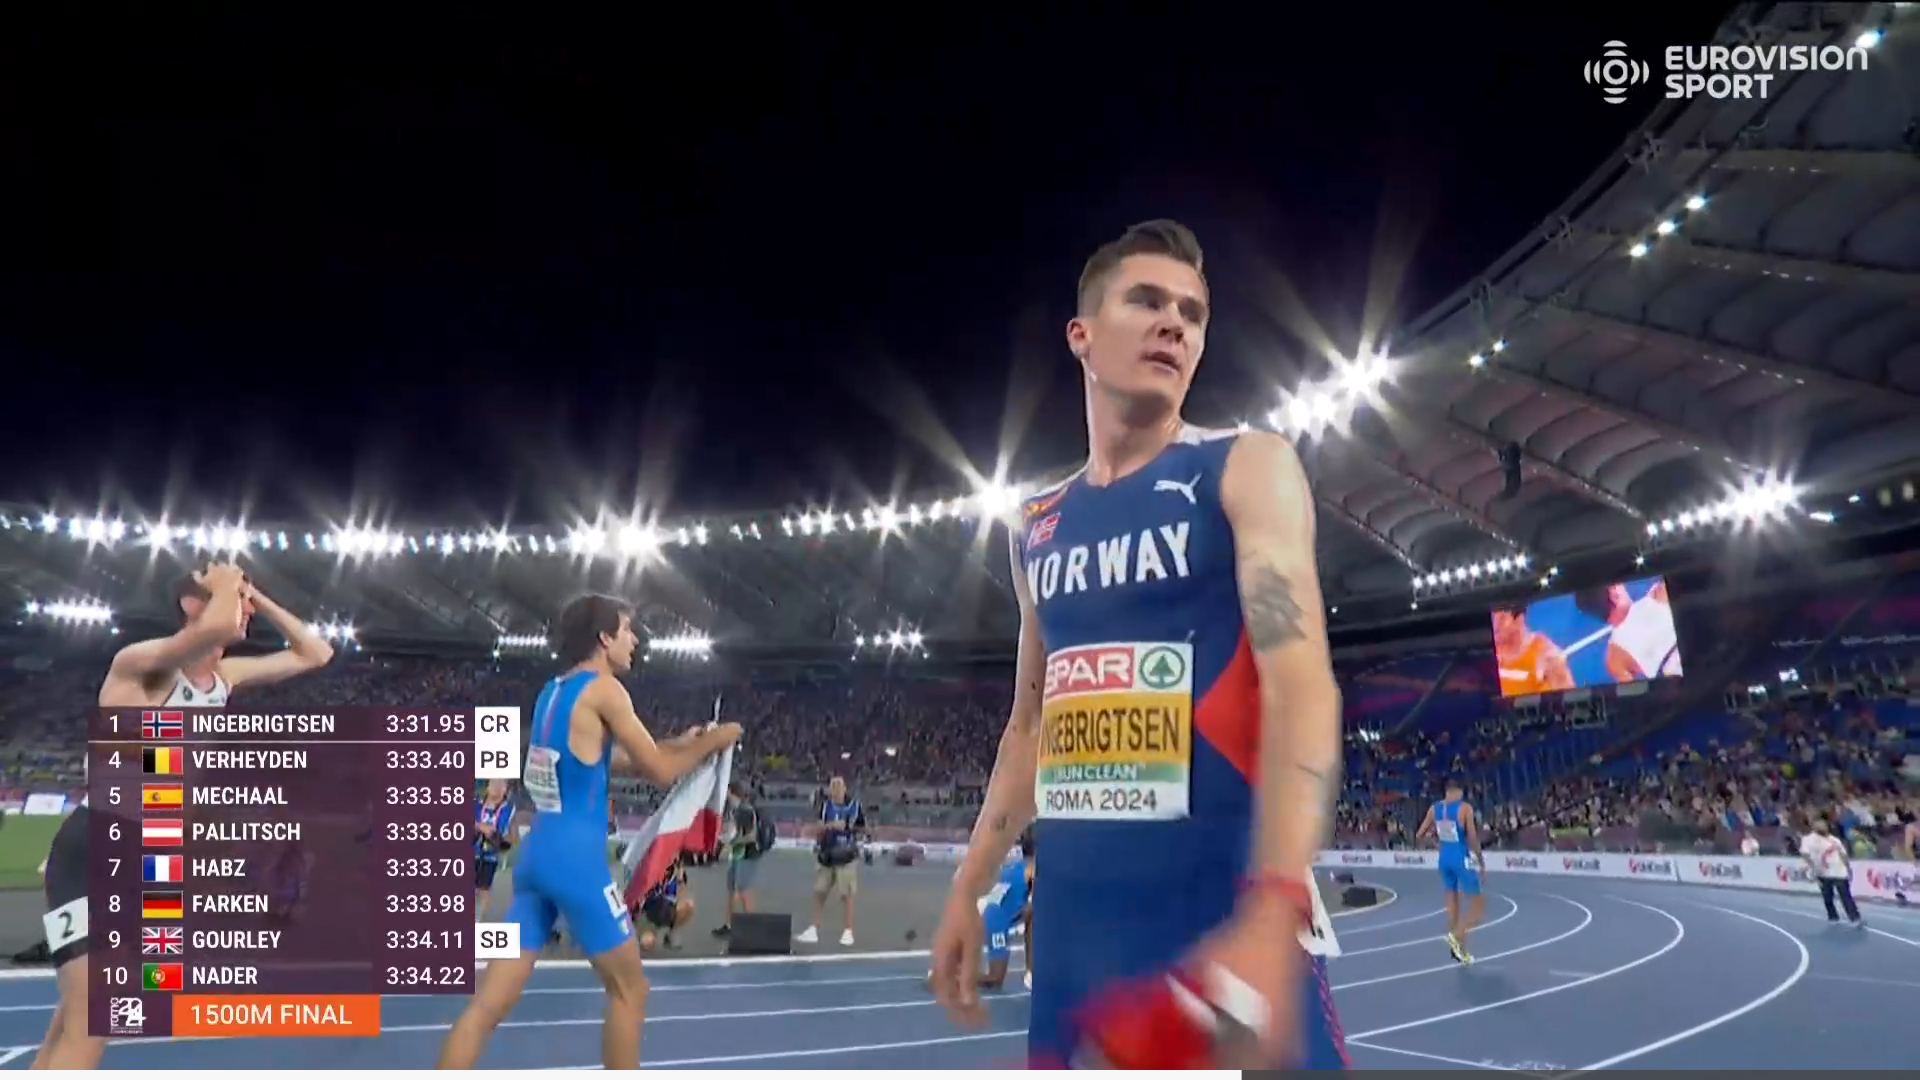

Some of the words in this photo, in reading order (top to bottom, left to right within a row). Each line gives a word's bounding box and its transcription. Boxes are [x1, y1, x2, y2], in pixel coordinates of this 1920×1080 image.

[1027, 521, 1191, 606] NORWAY
[1046, 788, 1093, 811] ROMA
[1100, 787, 1157, 812] 2024
[57, 910, 74, 939] 2
